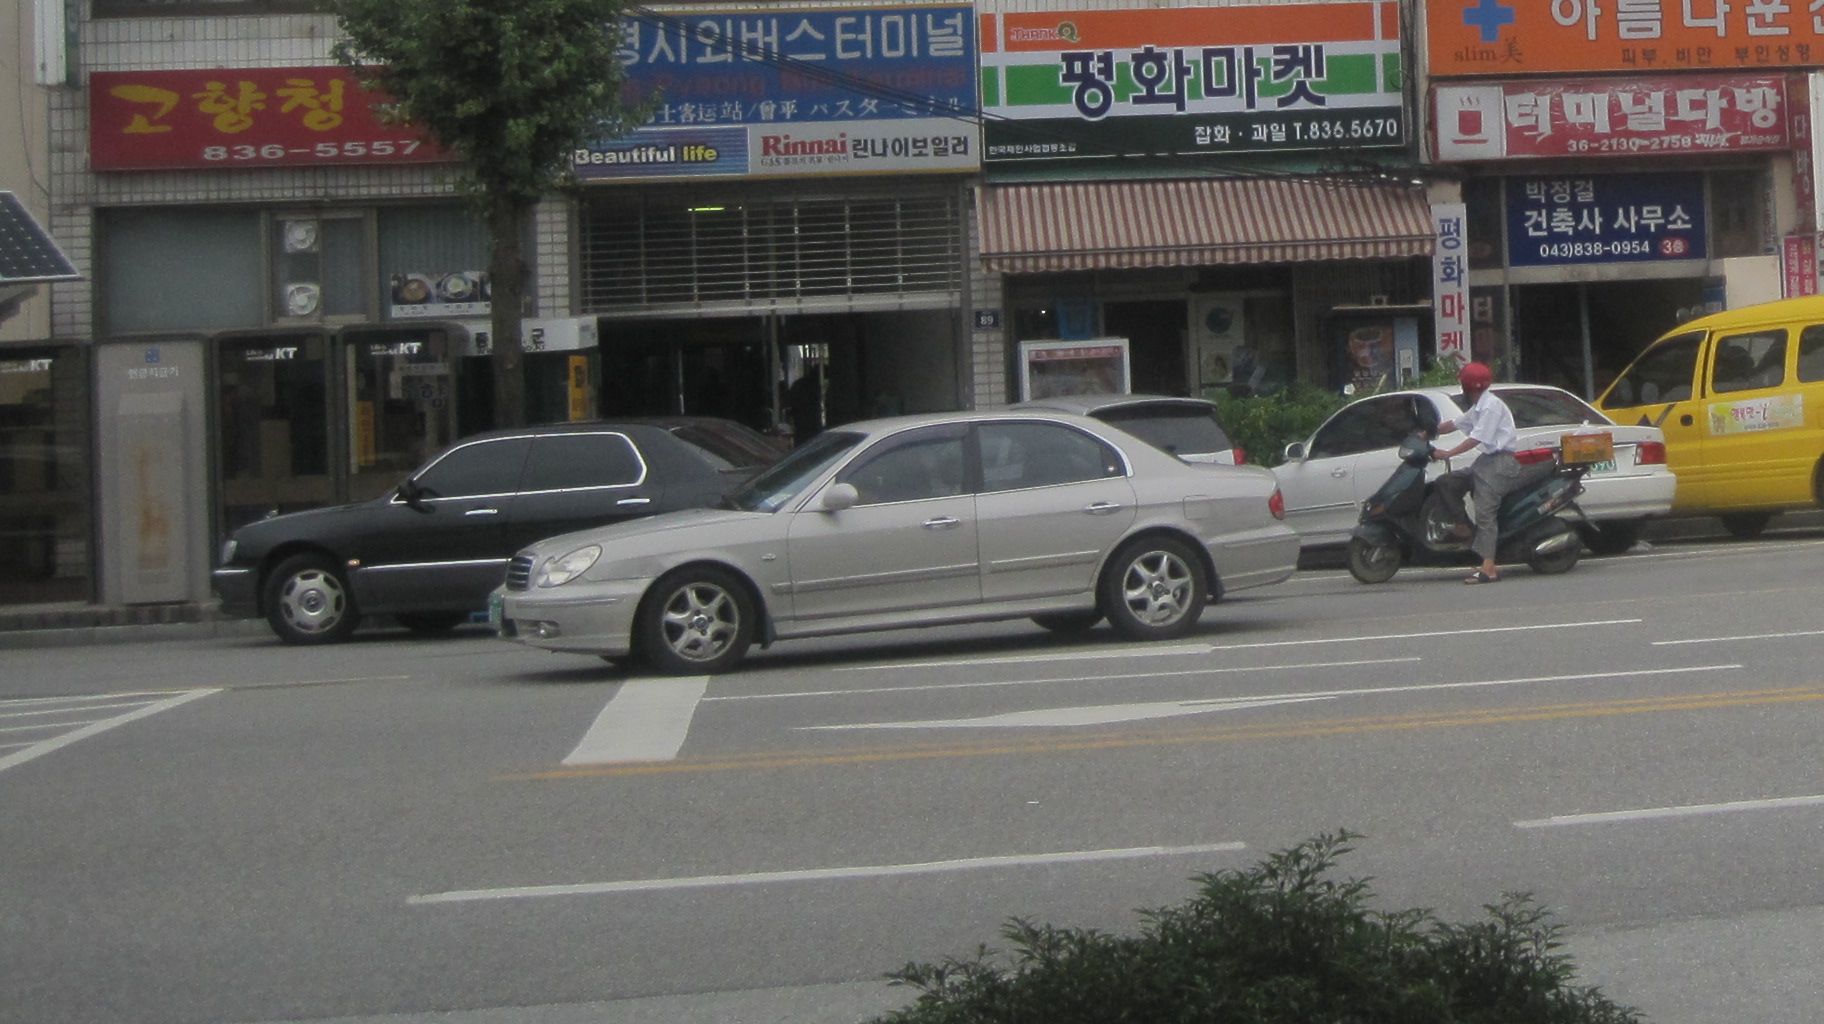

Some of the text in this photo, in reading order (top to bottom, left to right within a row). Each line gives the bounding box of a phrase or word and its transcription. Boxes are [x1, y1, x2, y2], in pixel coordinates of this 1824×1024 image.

[1059, 43, 1328, 122] 평화마켓
[1504, 84, 1782, 141] 터미널다방
[1250, 120, 1287, 143] 과일
[203, 139, 422, 162] 836-5557
[575, 146, 718, 166] Beautiful life
[760, 132, 848, 157] Rinnai
[851, 134, 970, 159] 린나이보일러
[1523, 204, 1694, 238] 건축사 사무소
[1539, 239, 1652, 259] 043)838-0954
